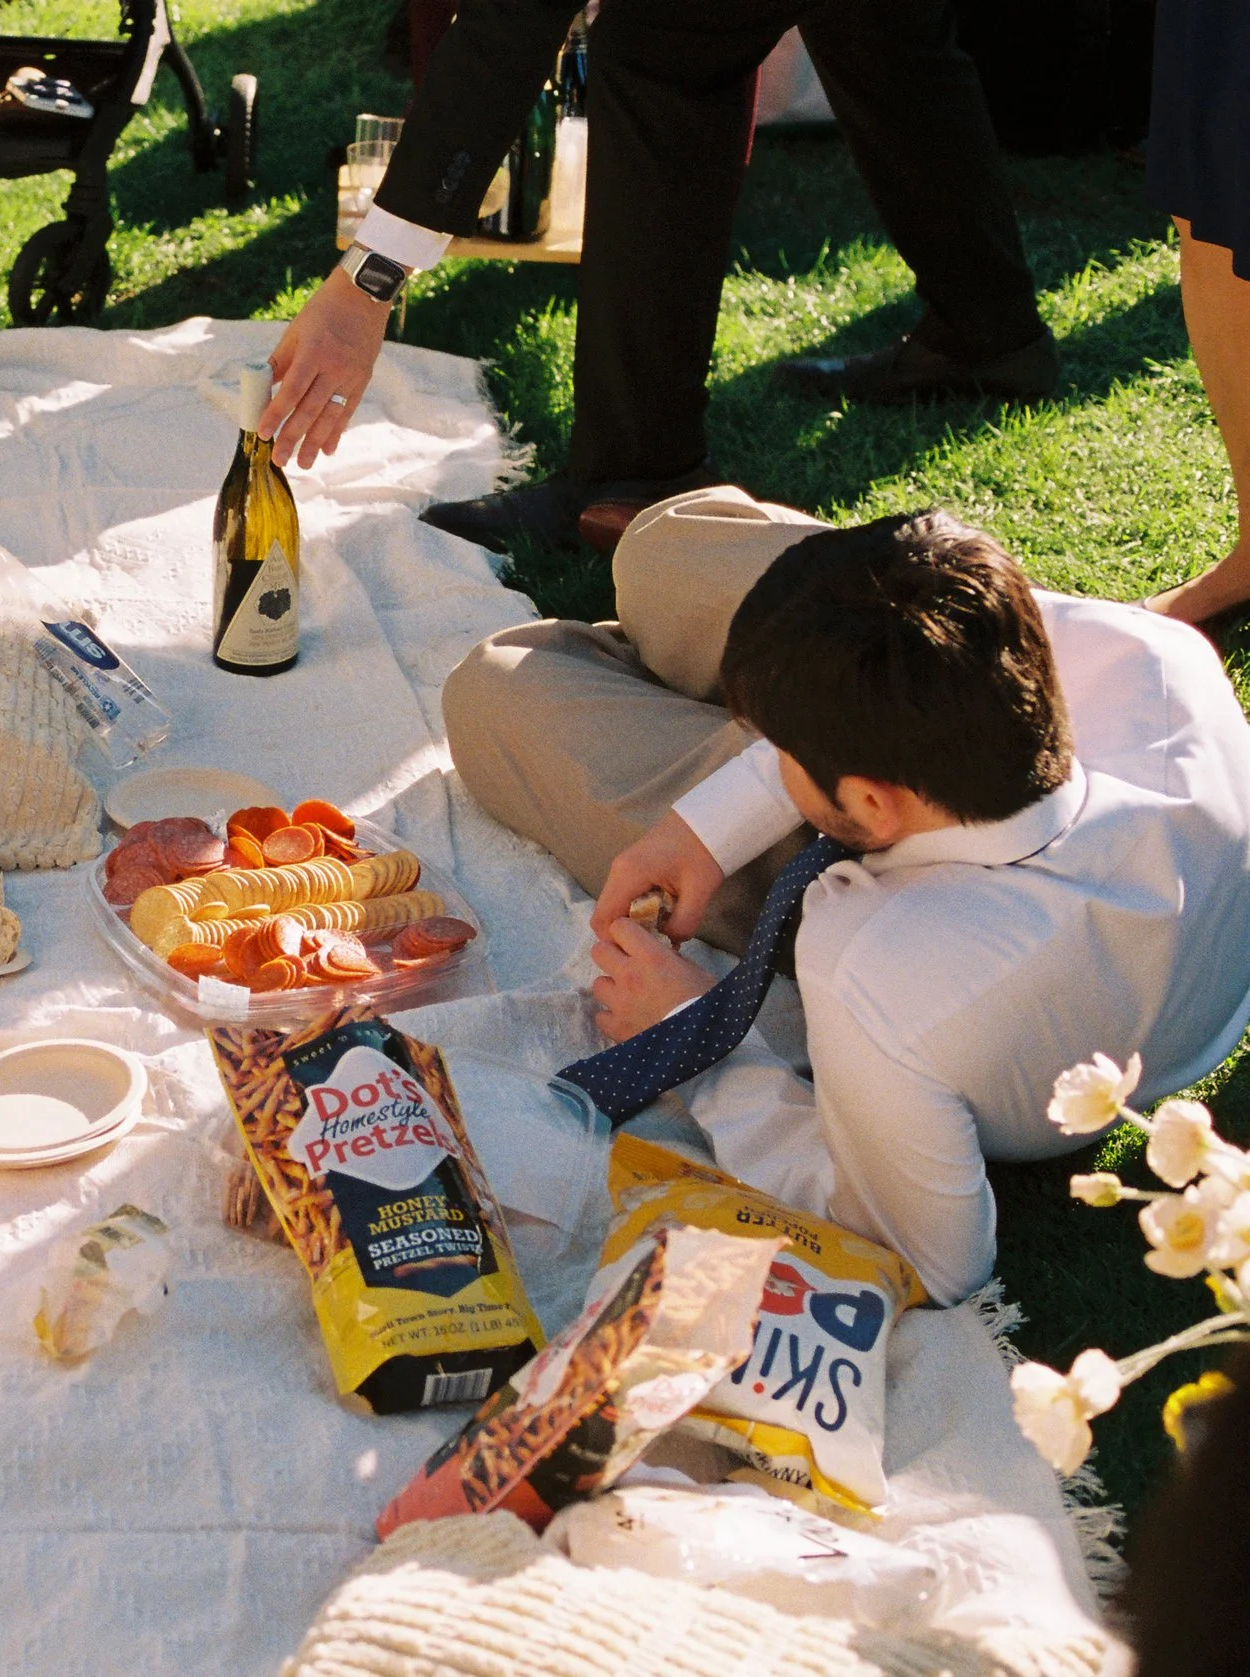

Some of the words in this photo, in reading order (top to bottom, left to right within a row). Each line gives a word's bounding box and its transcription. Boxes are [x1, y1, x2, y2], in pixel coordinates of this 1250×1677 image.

[59, 621, 106, 658] sm
[311, 1069, 423, 1121] Dot's
[320, 1102, 430, 1140] Homestyle
[305, 1118, 458, 1174] Pretzels
[368, 1208, 465, 1236] MUSTARD
[377, 1195, 448, 1220] HONEY
[368, 1229, 479, 1258] SEASONED
[736, 1209, 822, 1255] BUTTER
[373, 1245, 432, 1270] PRETZEL
